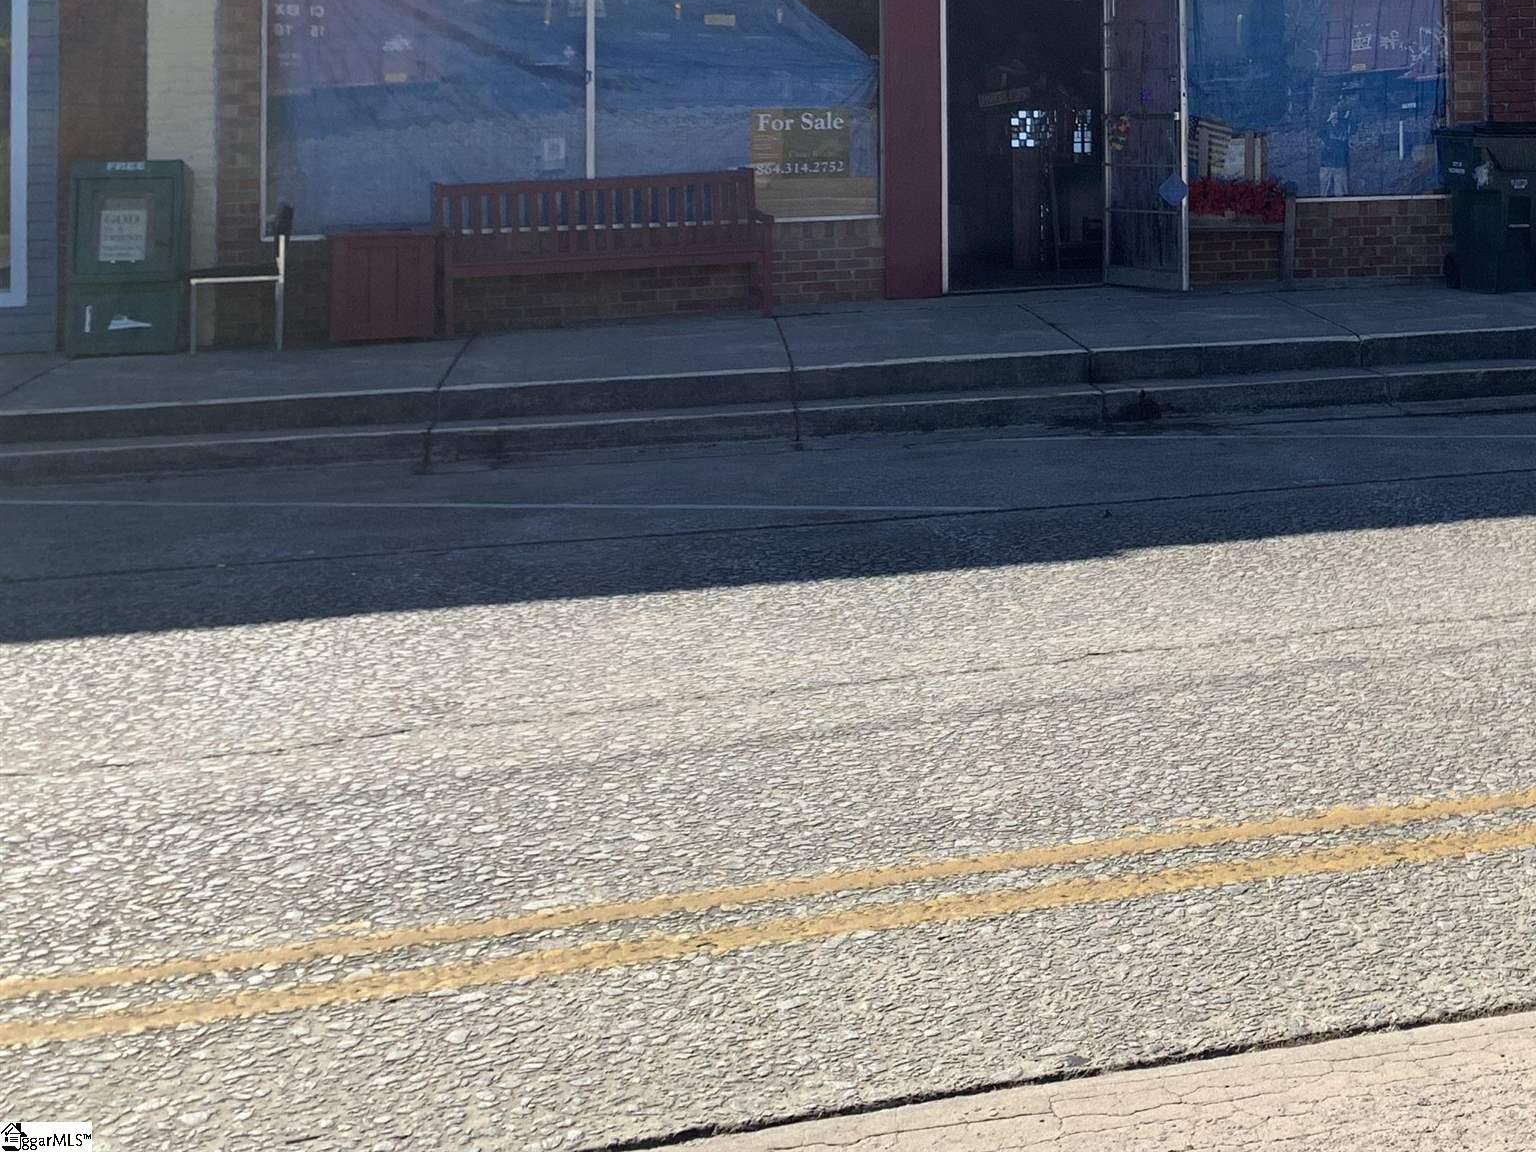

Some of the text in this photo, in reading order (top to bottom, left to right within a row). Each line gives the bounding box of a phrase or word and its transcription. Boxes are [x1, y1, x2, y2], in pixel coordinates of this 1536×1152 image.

[757, 111, 845, 131] For Sale
[107, 161, 145, 171] FREE
[755, 160, 845, 176] 864.314.2752
